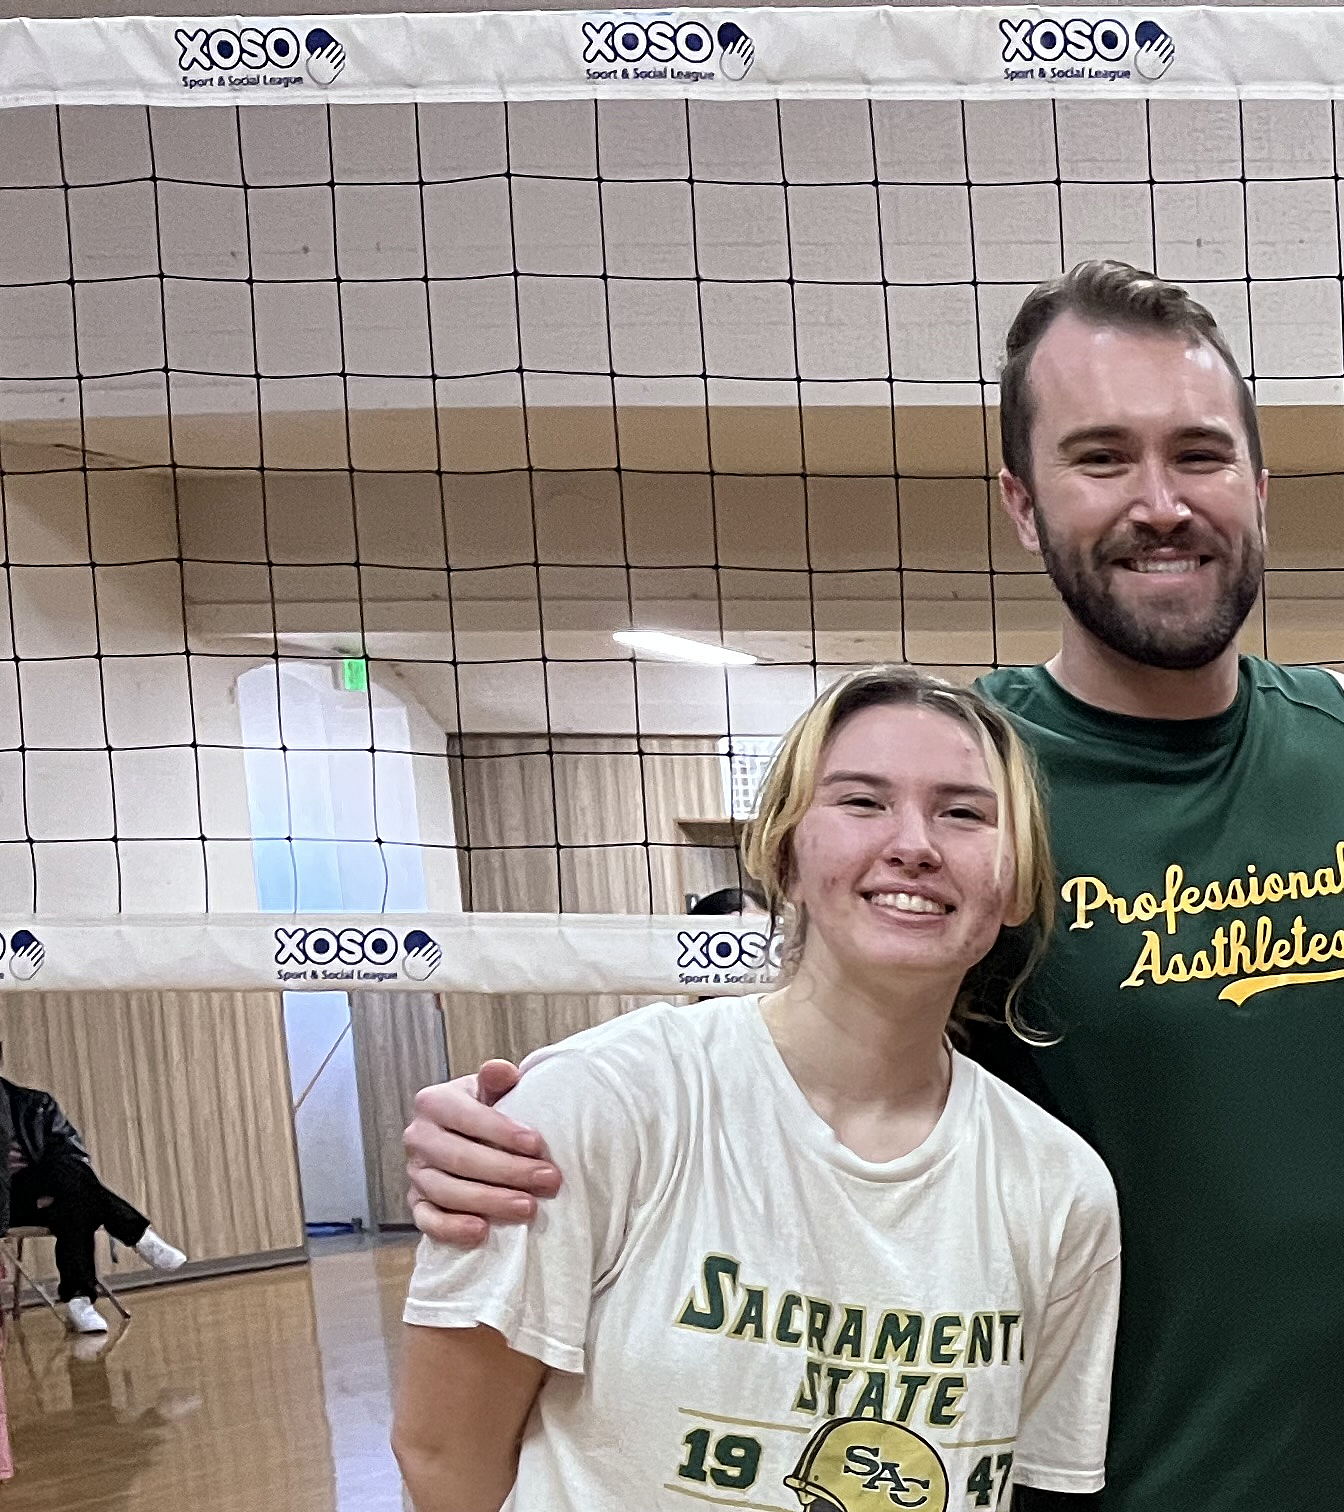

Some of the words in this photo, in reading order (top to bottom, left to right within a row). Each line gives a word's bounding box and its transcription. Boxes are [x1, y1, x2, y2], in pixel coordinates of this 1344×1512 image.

[175, 28, 300, 71] XOSO
[582, 21, 713, 63] XOSO
[1000, 19, 1129, 61] XOSO
[182, 76, 213, 88] Sport
[228, 76, 259, 85] Social
[263, 75, 303, 87] League
[586, 68, 617, 80] Sport
[634, 67, 667, 79] Social
[671, 69, 714, 81] League
[1004, 69, 1034, 80] Sport
[1051, 68, 1084, 79] Social
[1088, 69, 1130, 80] League
[275, 928, 398, 965] XOSO
[277, 970, 308, 981] Sport
[322, 970, 354, 979] Social
[357, 970, 397, 982] League
[679, 974, 709, 984] Sport
[675, 1251, 1024, 1367] SACRAMENT
[791, 1361, 969, 1429] STATE
[677, 1428, 763, 1490] 19
[843, 1445, 930, 1508] SAC
